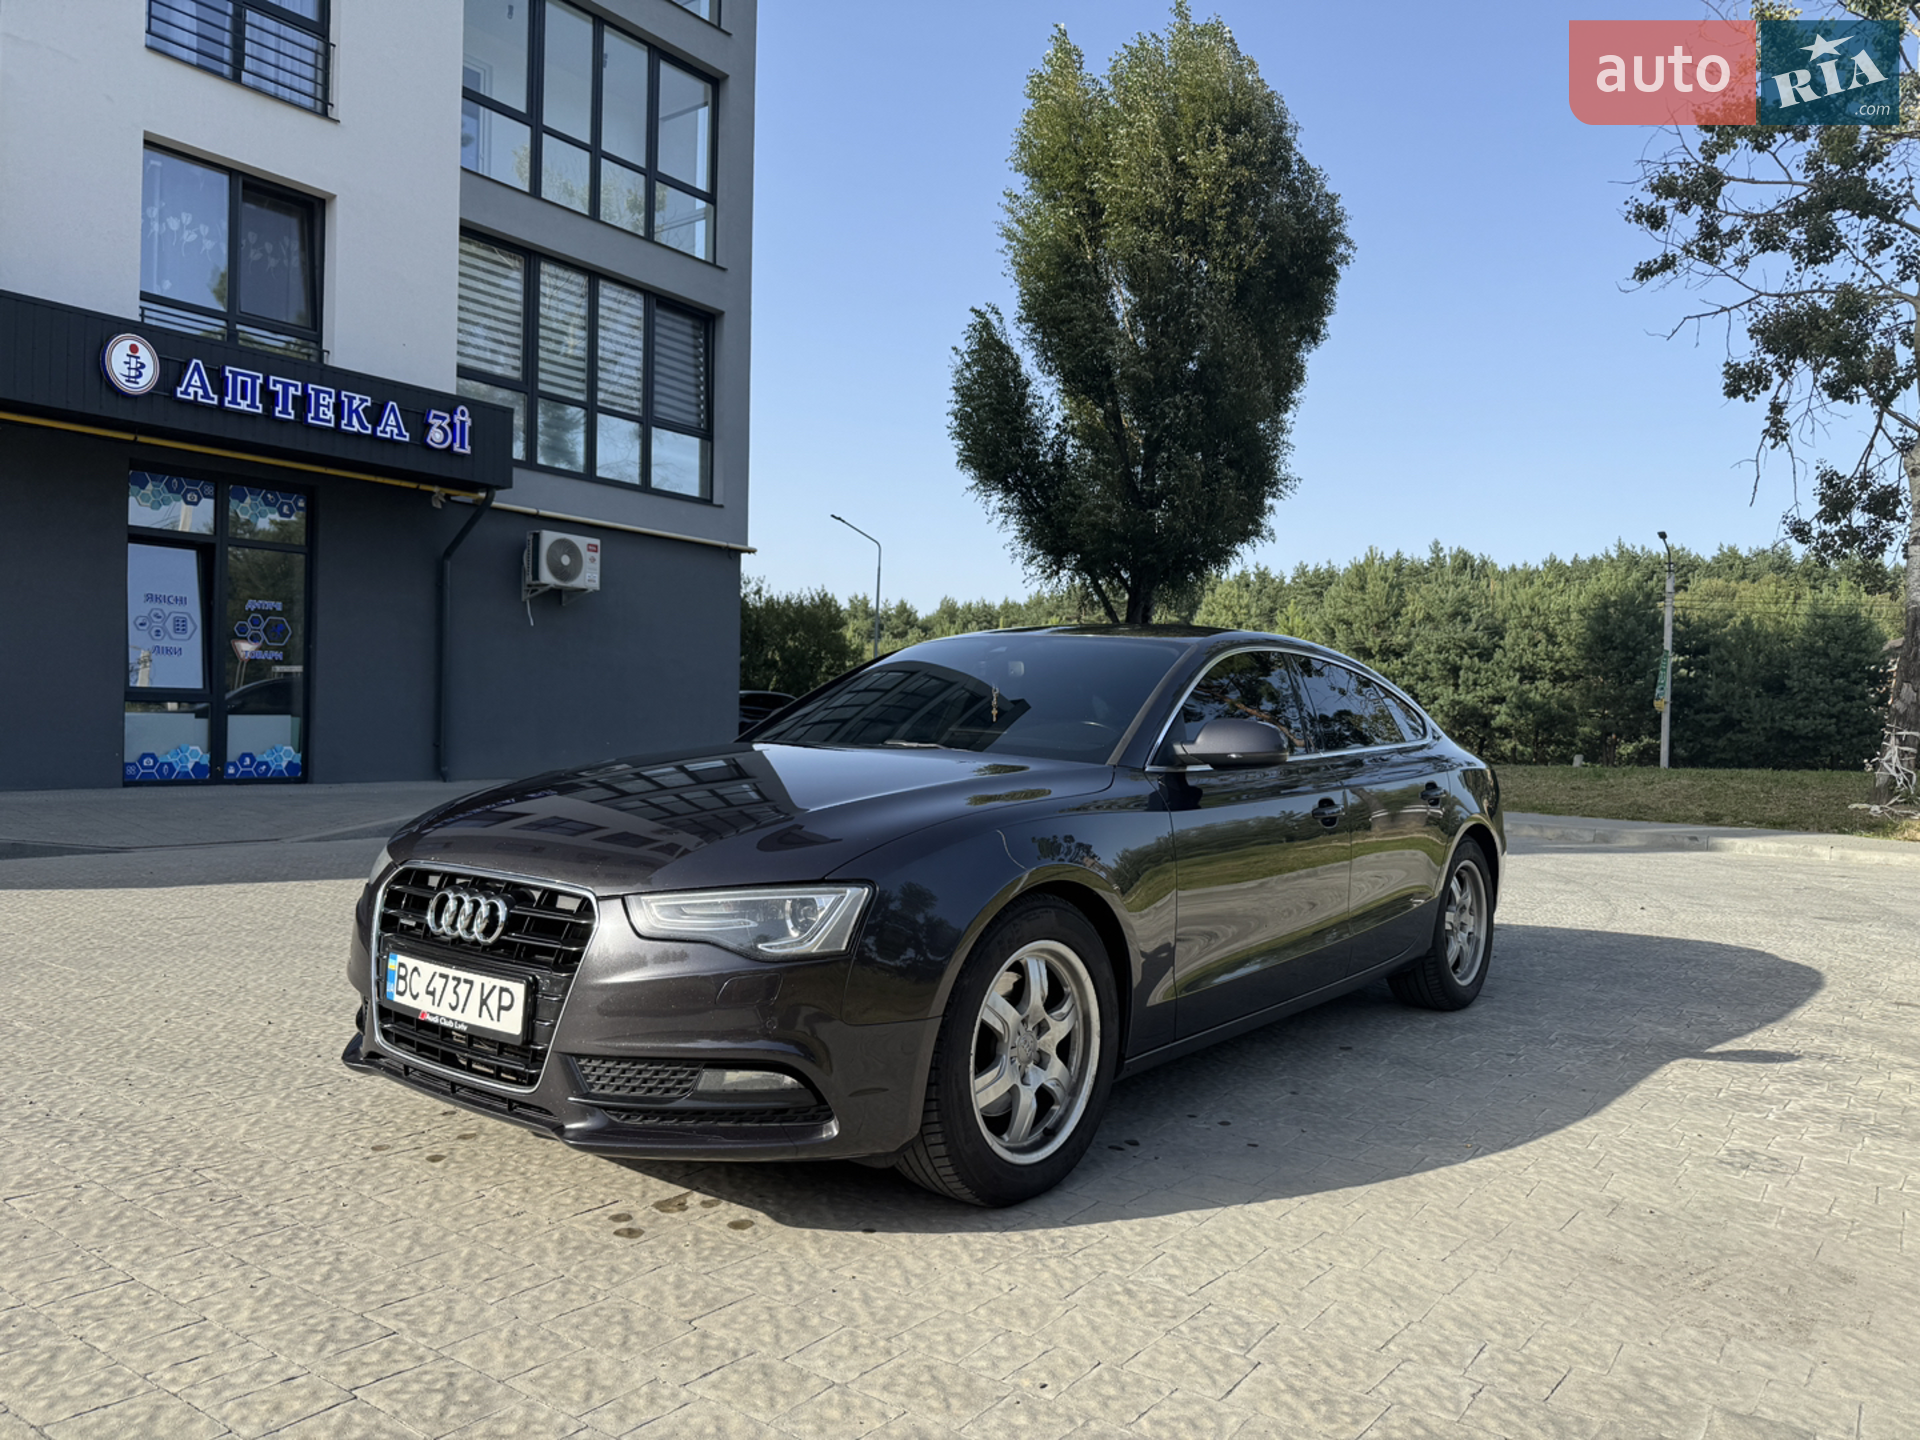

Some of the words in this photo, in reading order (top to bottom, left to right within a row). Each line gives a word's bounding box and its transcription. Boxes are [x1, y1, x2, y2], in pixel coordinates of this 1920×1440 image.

[174, 358, 410, 442] АПТЕКА
[143, 592, 188, 606] ЯКІСНІ
[151, 645, 183, 657] ЛІКИ
[395, 961, 422, 1001] BC
[424, 971, 475, 1014] 4737
[477, 981, 515, 1023] KP
